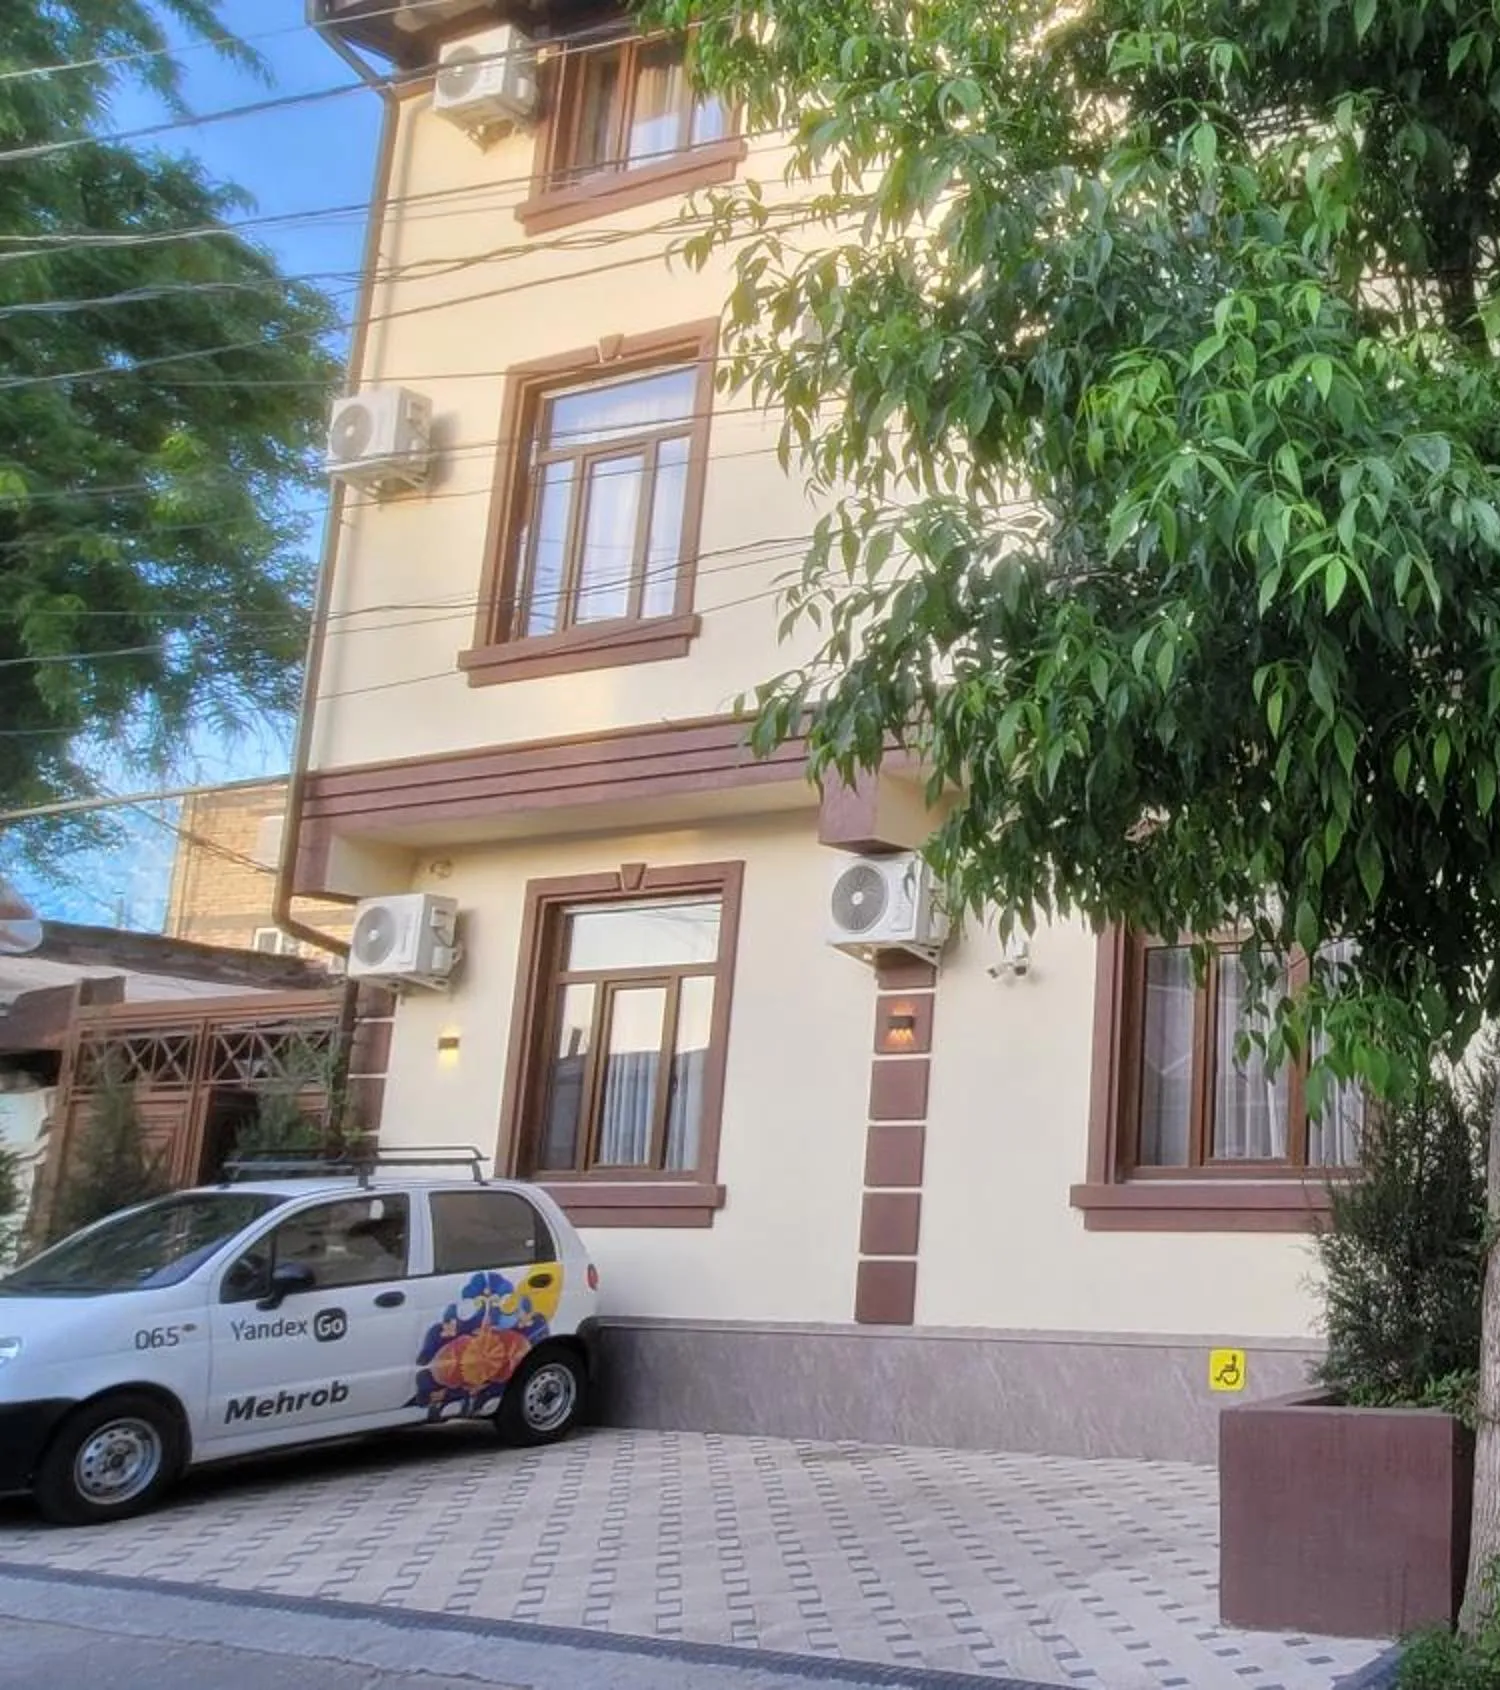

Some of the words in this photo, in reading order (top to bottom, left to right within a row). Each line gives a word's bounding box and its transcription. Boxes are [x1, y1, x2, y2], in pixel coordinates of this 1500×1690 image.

[135, 1326, 180, 1350] 065
[230, 1317, 308, 1341] Yandex
[315, 1312, 345, 1339] Go
[224, 1380, 349, 1424] Mehrob
